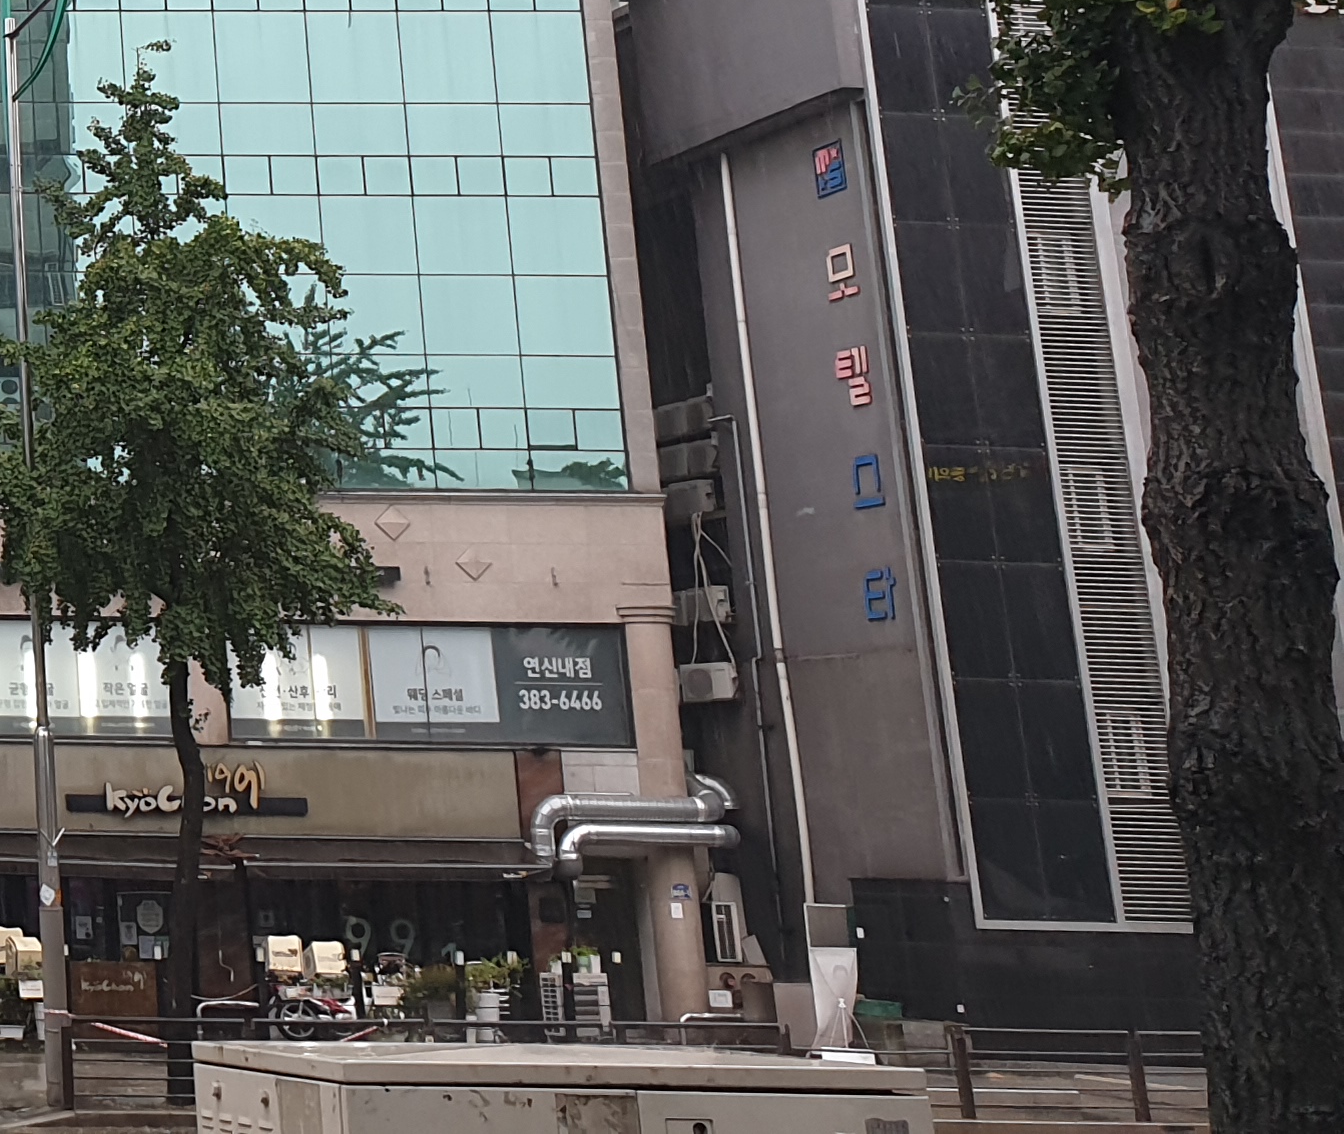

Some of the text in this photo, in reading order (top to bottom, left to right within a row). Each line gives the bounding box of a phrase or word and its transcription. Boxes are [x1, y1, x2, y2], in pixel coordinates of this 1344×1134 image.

[523, 656, 592, 679] 연신내점
[518, 689, 603, 711] 383-6466
[105, 782, 238, 818] KyoCon
